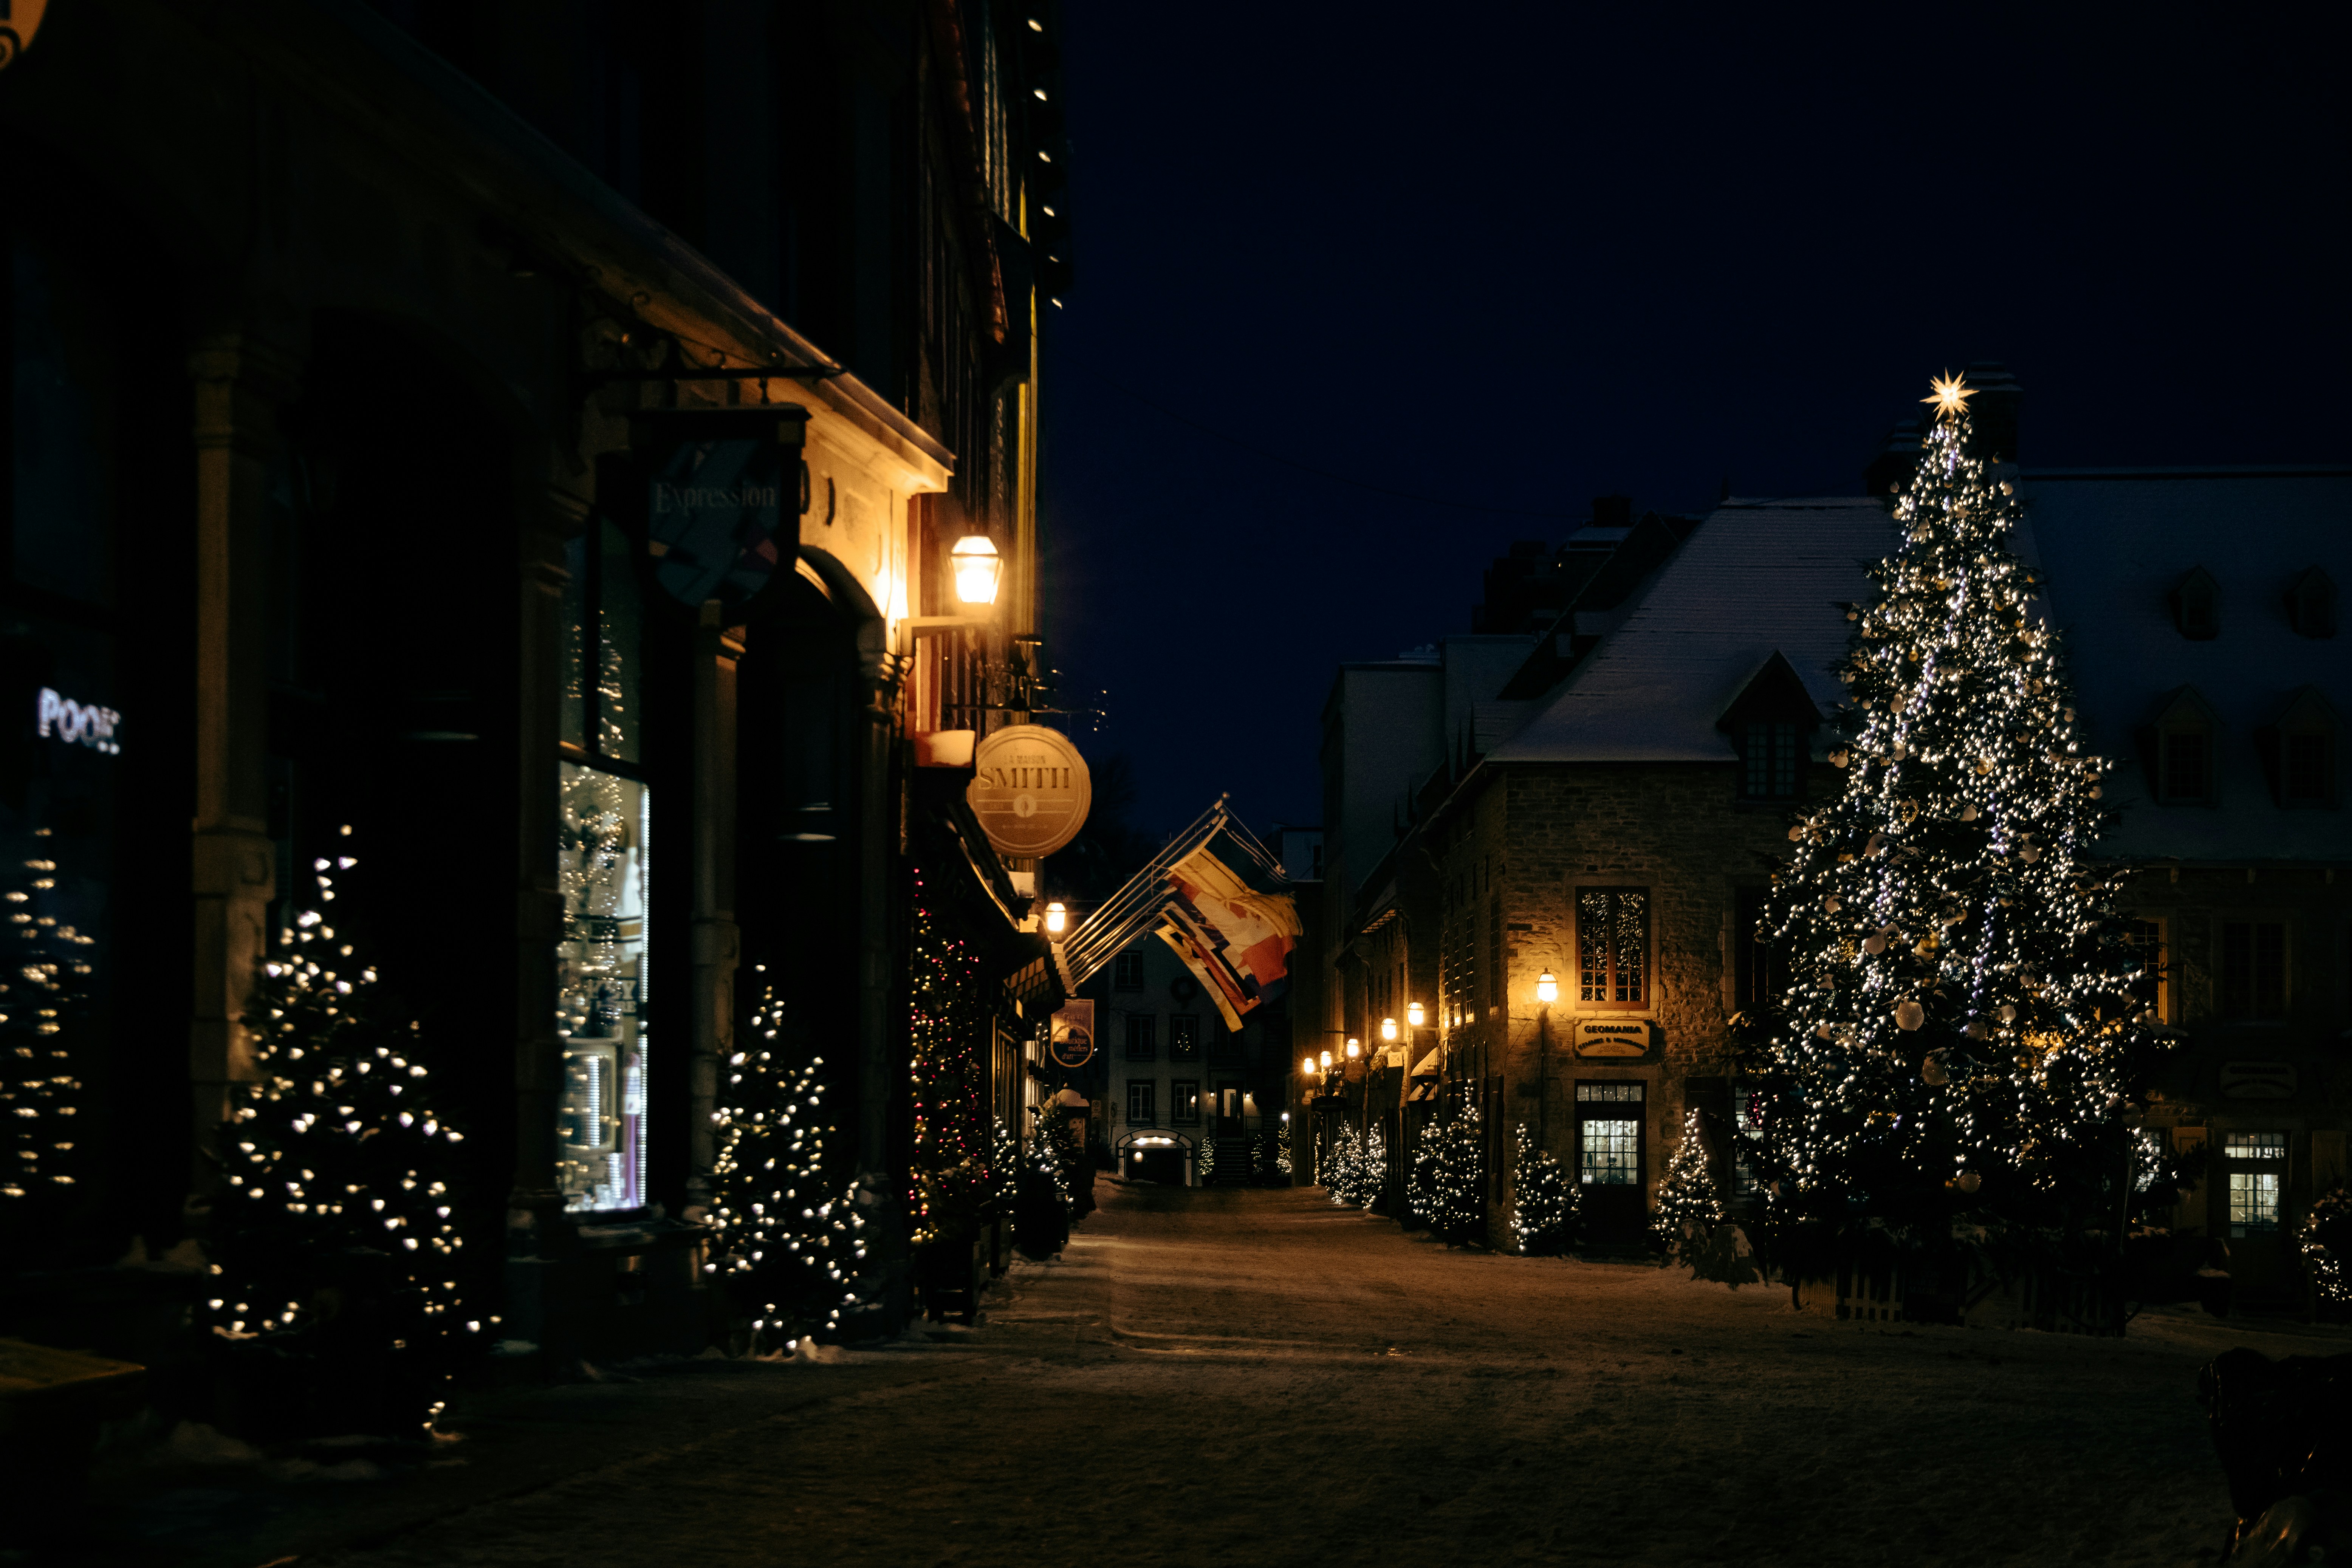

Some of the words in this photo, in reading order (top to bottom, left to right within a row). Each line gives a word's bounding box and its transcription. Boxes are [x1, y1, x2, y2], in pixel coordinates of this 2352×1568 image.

[655, 481, 775, 515] Expression
[979, 767, 1070, 789] SMITH
[1584, 1025, 1643, 1034] GEOMANIA
[2230, 1066, 2288, 1074] GEOMANIA
[1909, 1286, 1938, 1295] MAGIE
